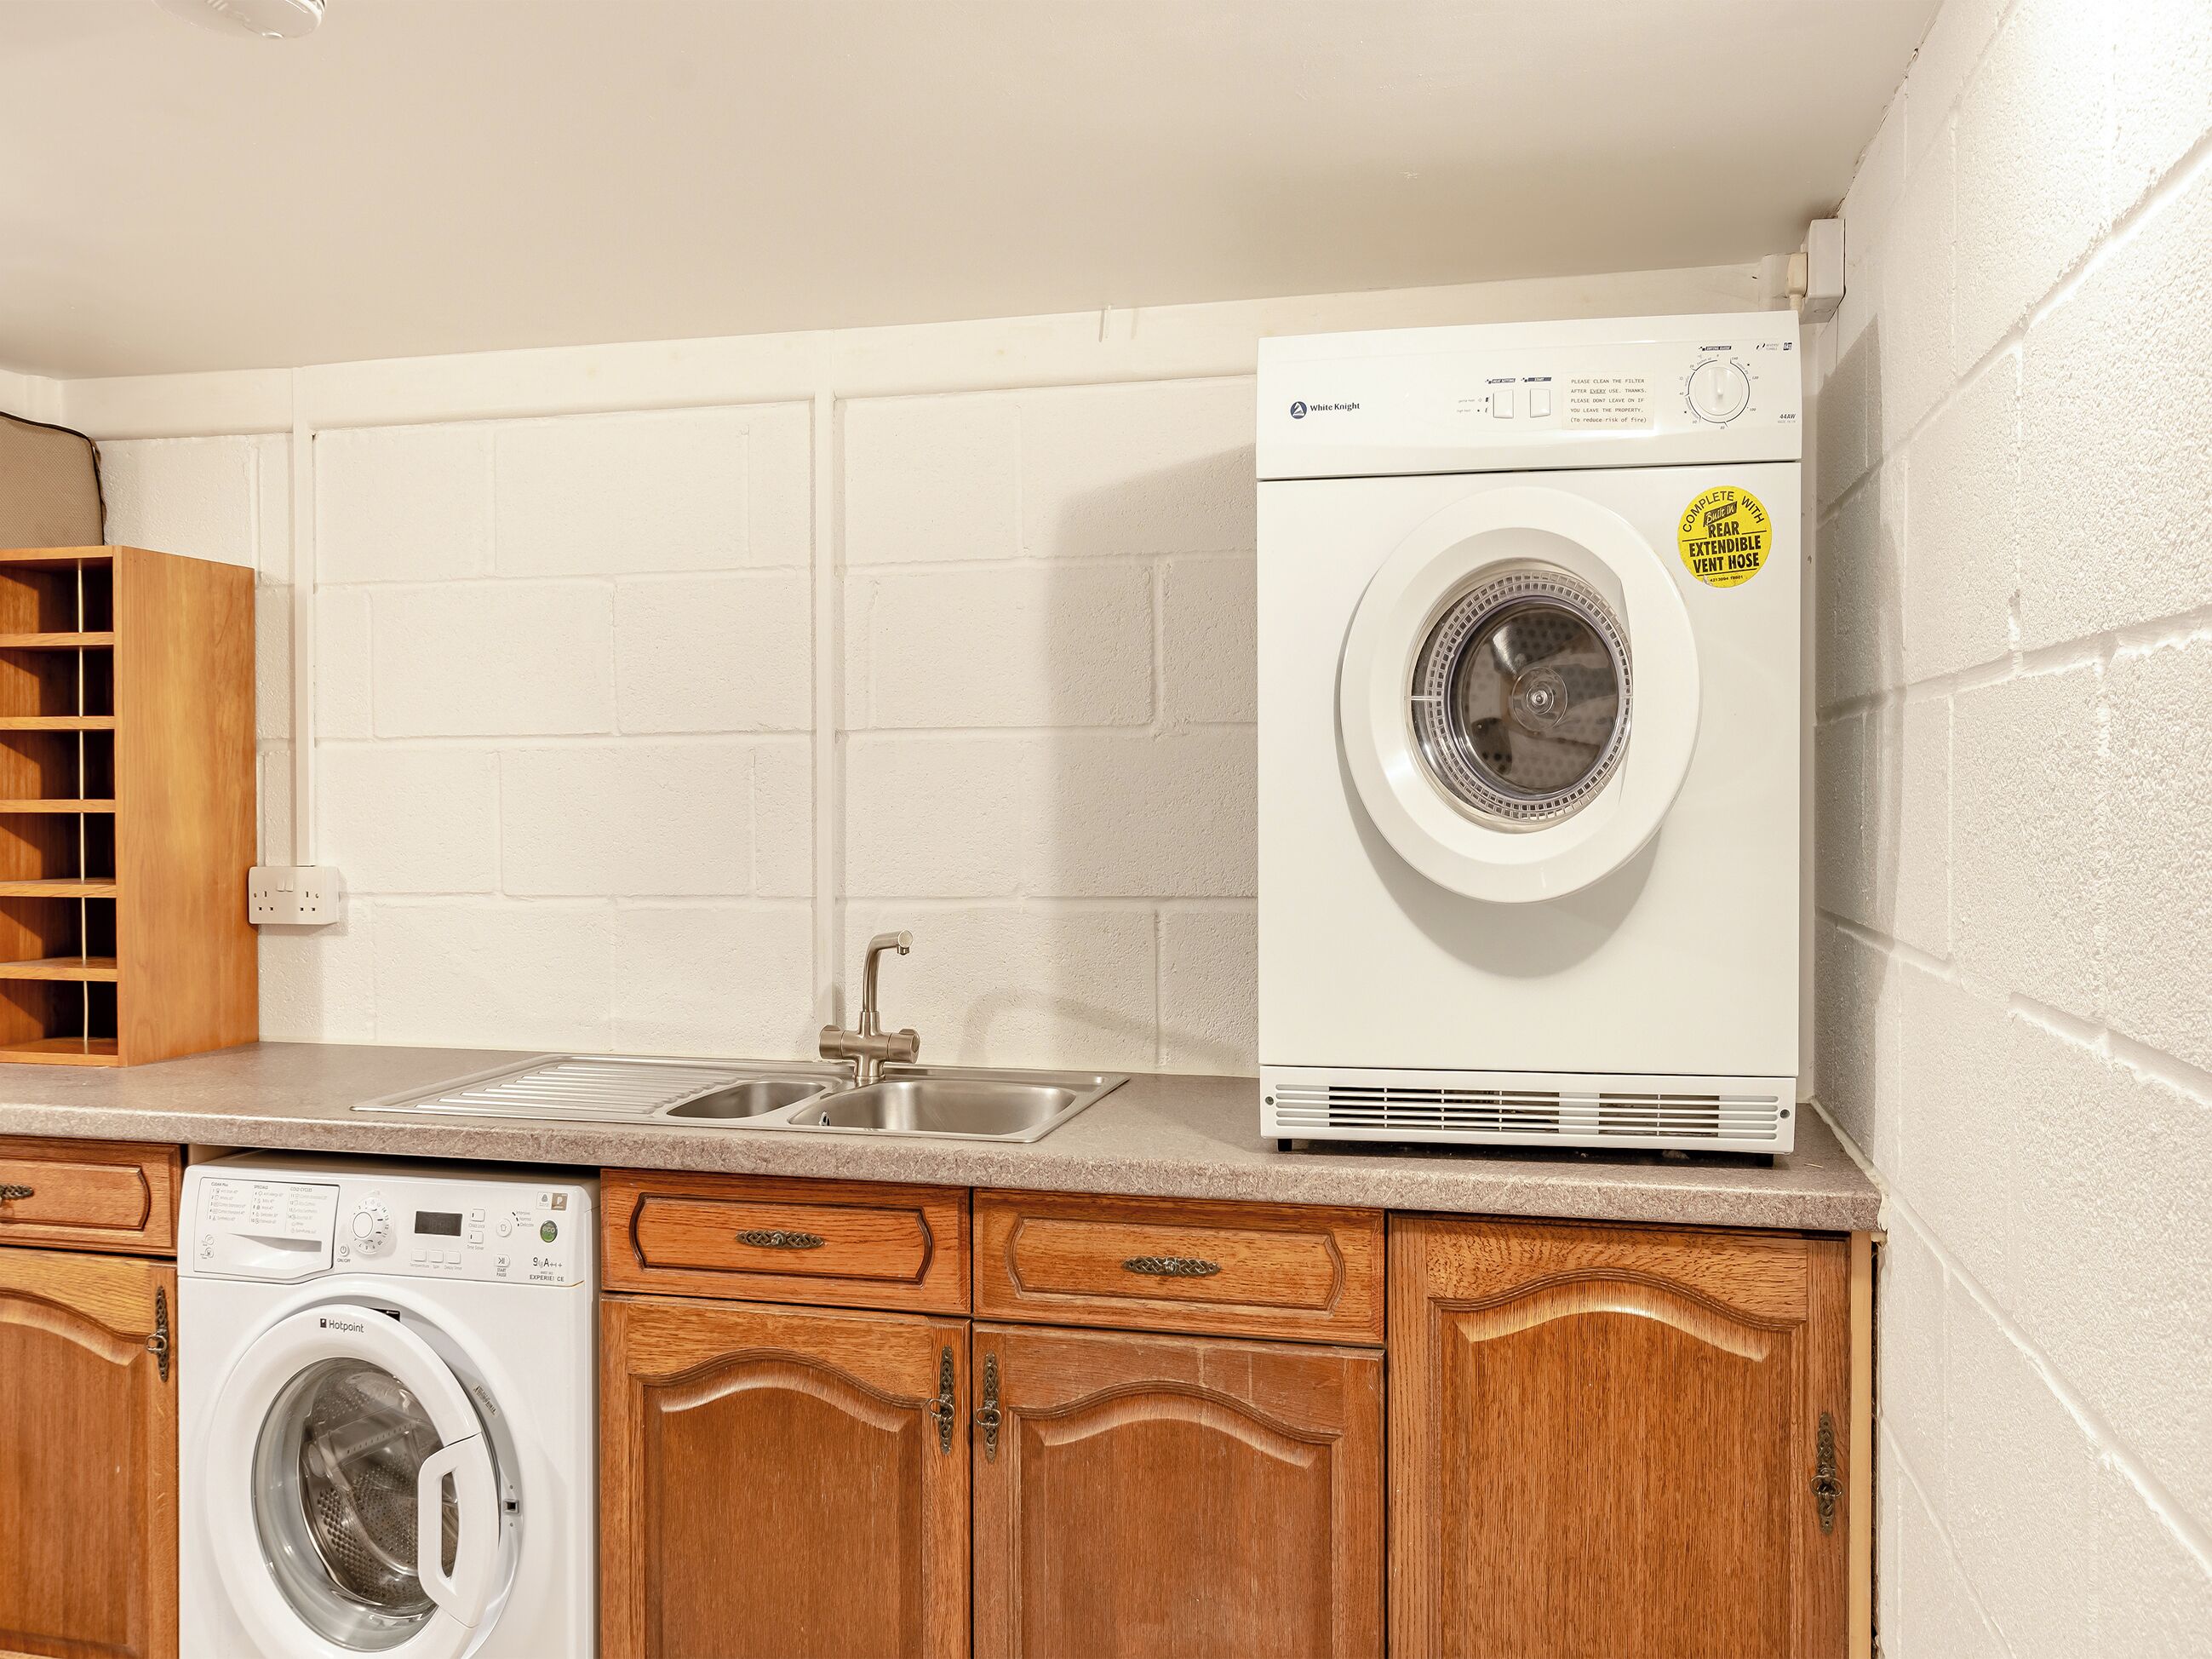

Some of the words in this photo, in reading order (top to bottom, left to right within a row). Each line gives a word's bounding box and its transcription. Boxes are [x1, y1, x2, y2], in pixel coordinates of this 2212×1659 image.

[1310, 404, 1333, 412] White
[1334, 402, 1361, 411] Knight
[1682, 491, 1734, 532] COMPLETE
[1741, 496, 1765, 524] WITH
[1705, 507, 1726, 524] Built
[1727, 504, 1734, 514] in
[1708, 520, 1739, 538] REAR
[1689, 535, 1762, 557] EXTENDIBLE
[1693, 556, 1724, 573] VENT
[1728, 552, 1760, 570] HOSE
[330, 1320, 364, 1333] Hotpoint
